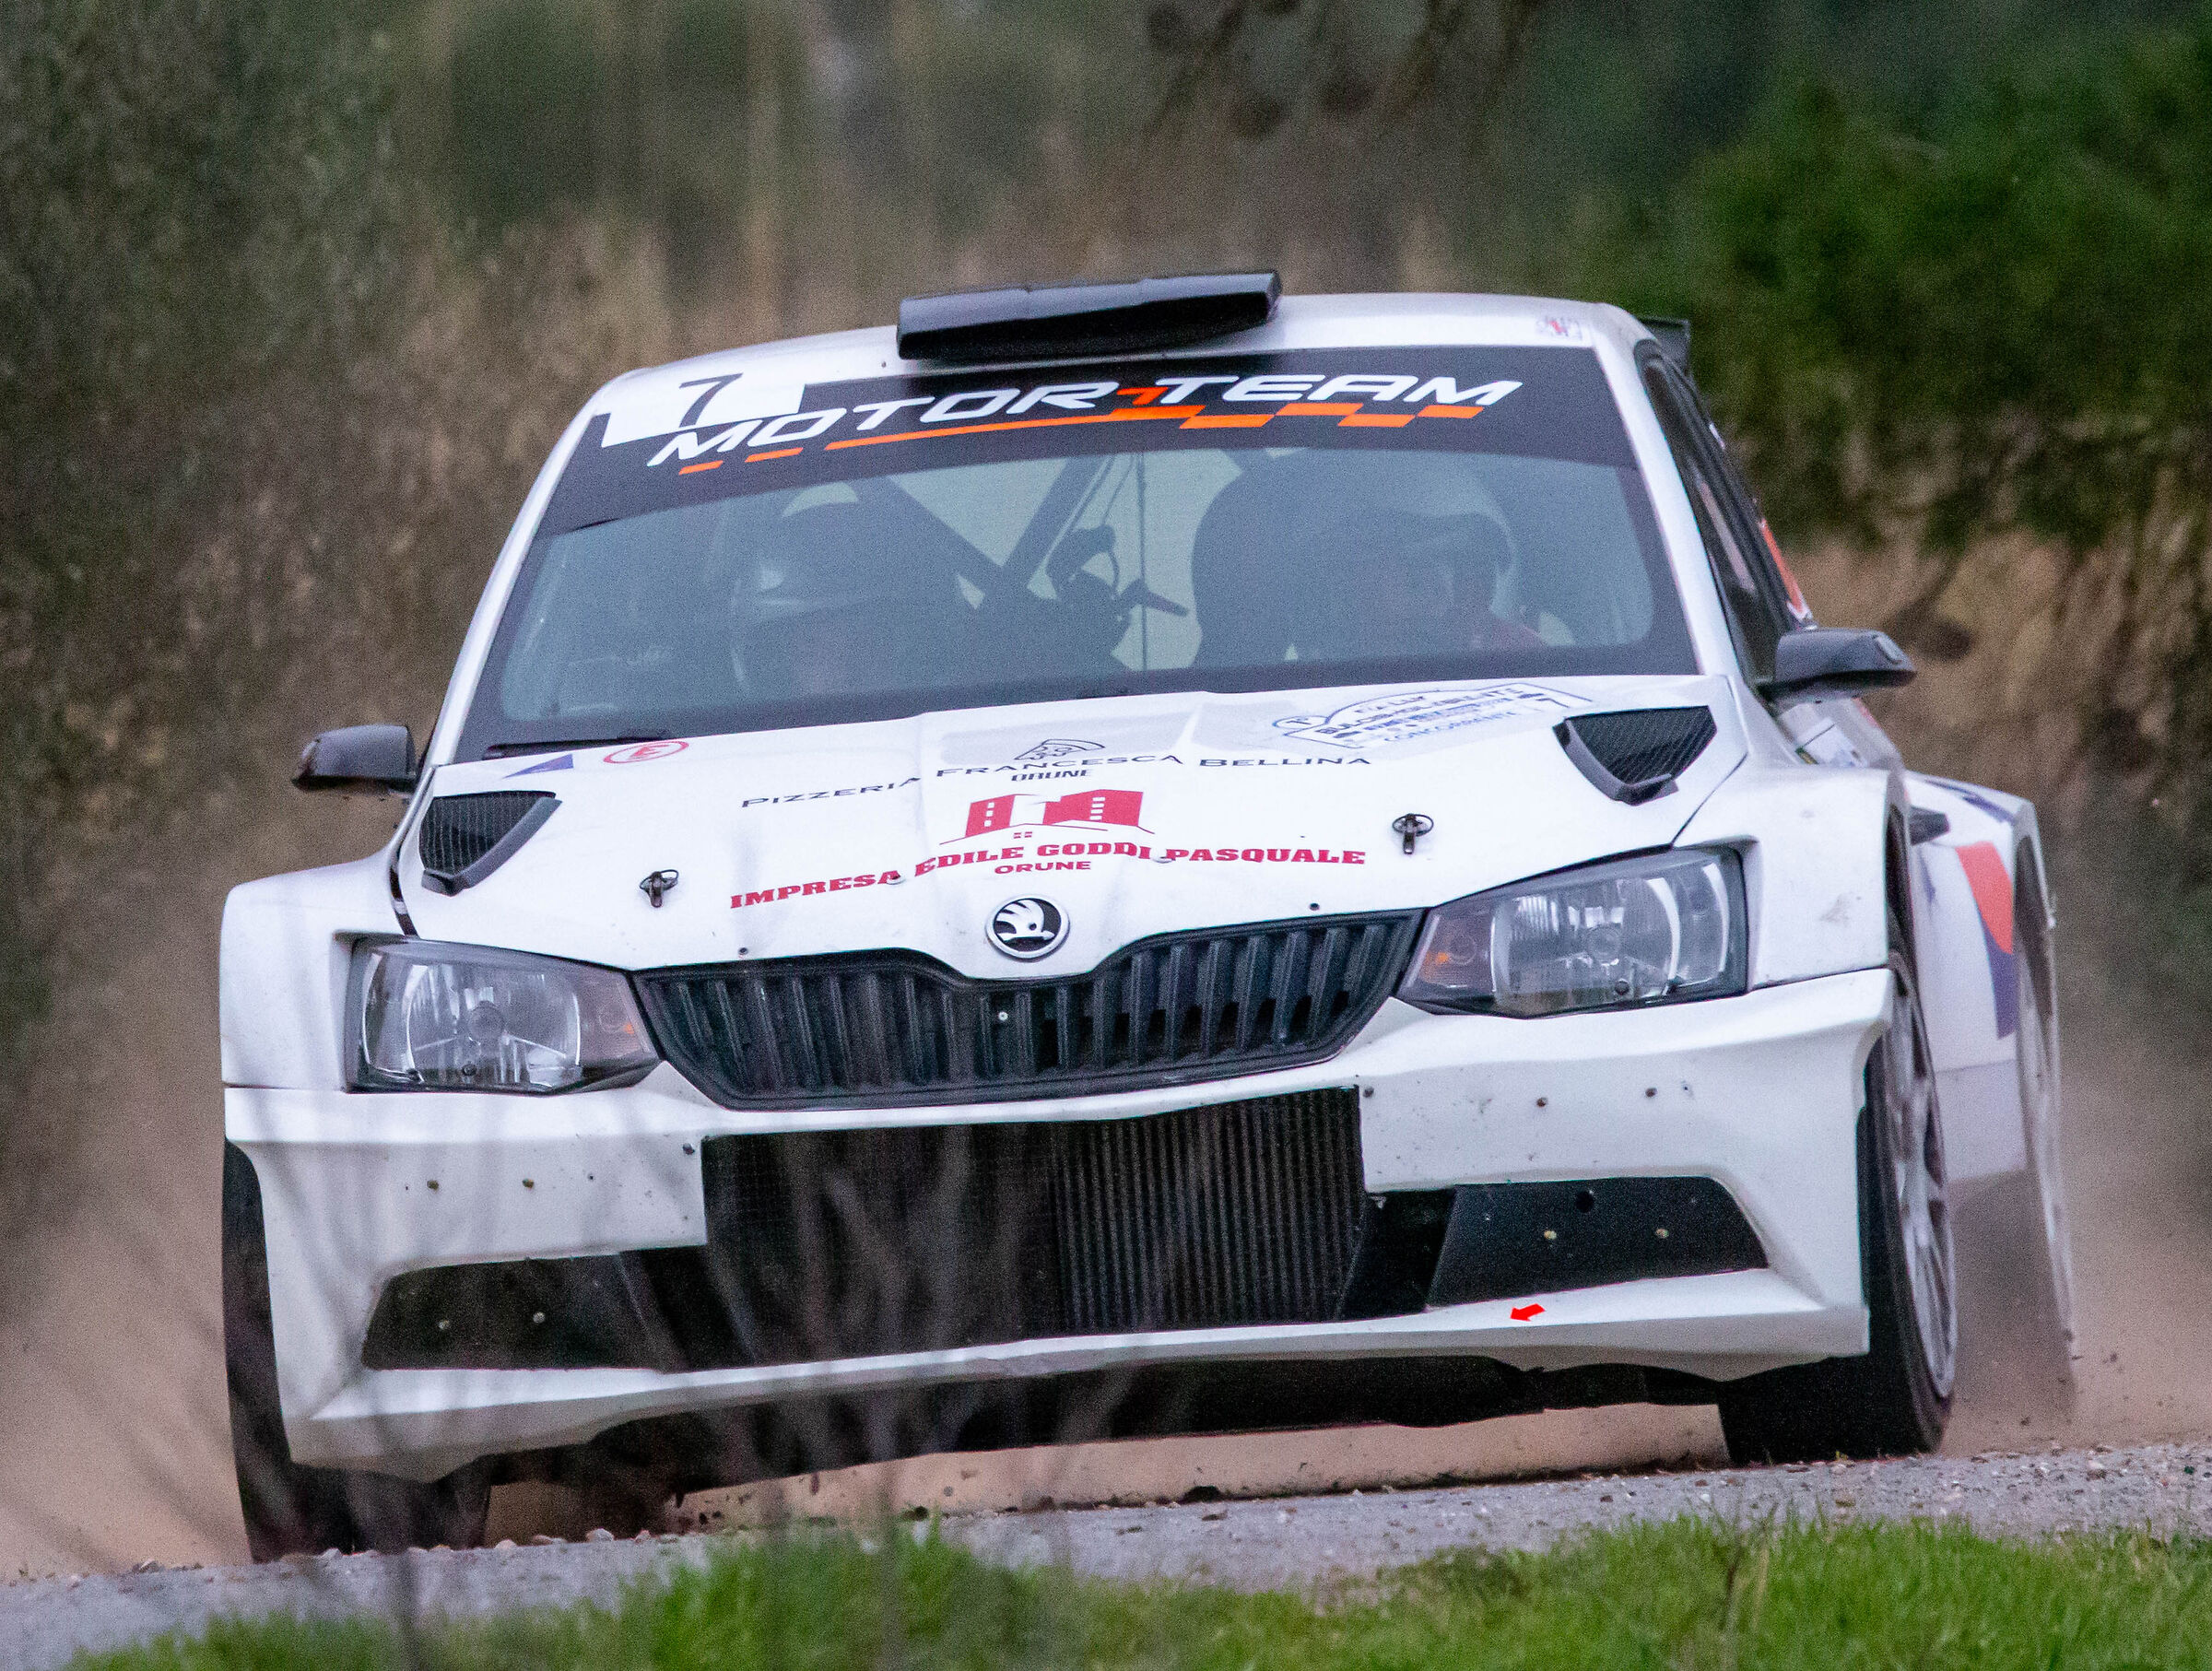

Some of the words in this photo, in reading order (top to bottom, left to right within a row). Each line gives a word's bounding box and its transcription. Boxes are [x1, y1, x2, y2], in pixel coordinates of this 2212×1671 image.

[647, 381, 1120, 467] MOTOR
[1154, 374, 1524, 406] TEAM
[679, 371, 744, 428] 7
[742, 776, 921, 807] PIZZERIA
[935, 754, 1184, 777] FRANCESCA
[1198, 757, 1371, 768] BELLINA
[1011, 768, 1092, 782] ORUNE
[730, 869, 901, 909] IMPRESA
[914, 846, 1024, 877] EDILE
[1037, 841, 1152, 860] GODDI
[1165, 848, 1367, 865] PASQUALE
[994, 860, 1091, 875] ORUNE
